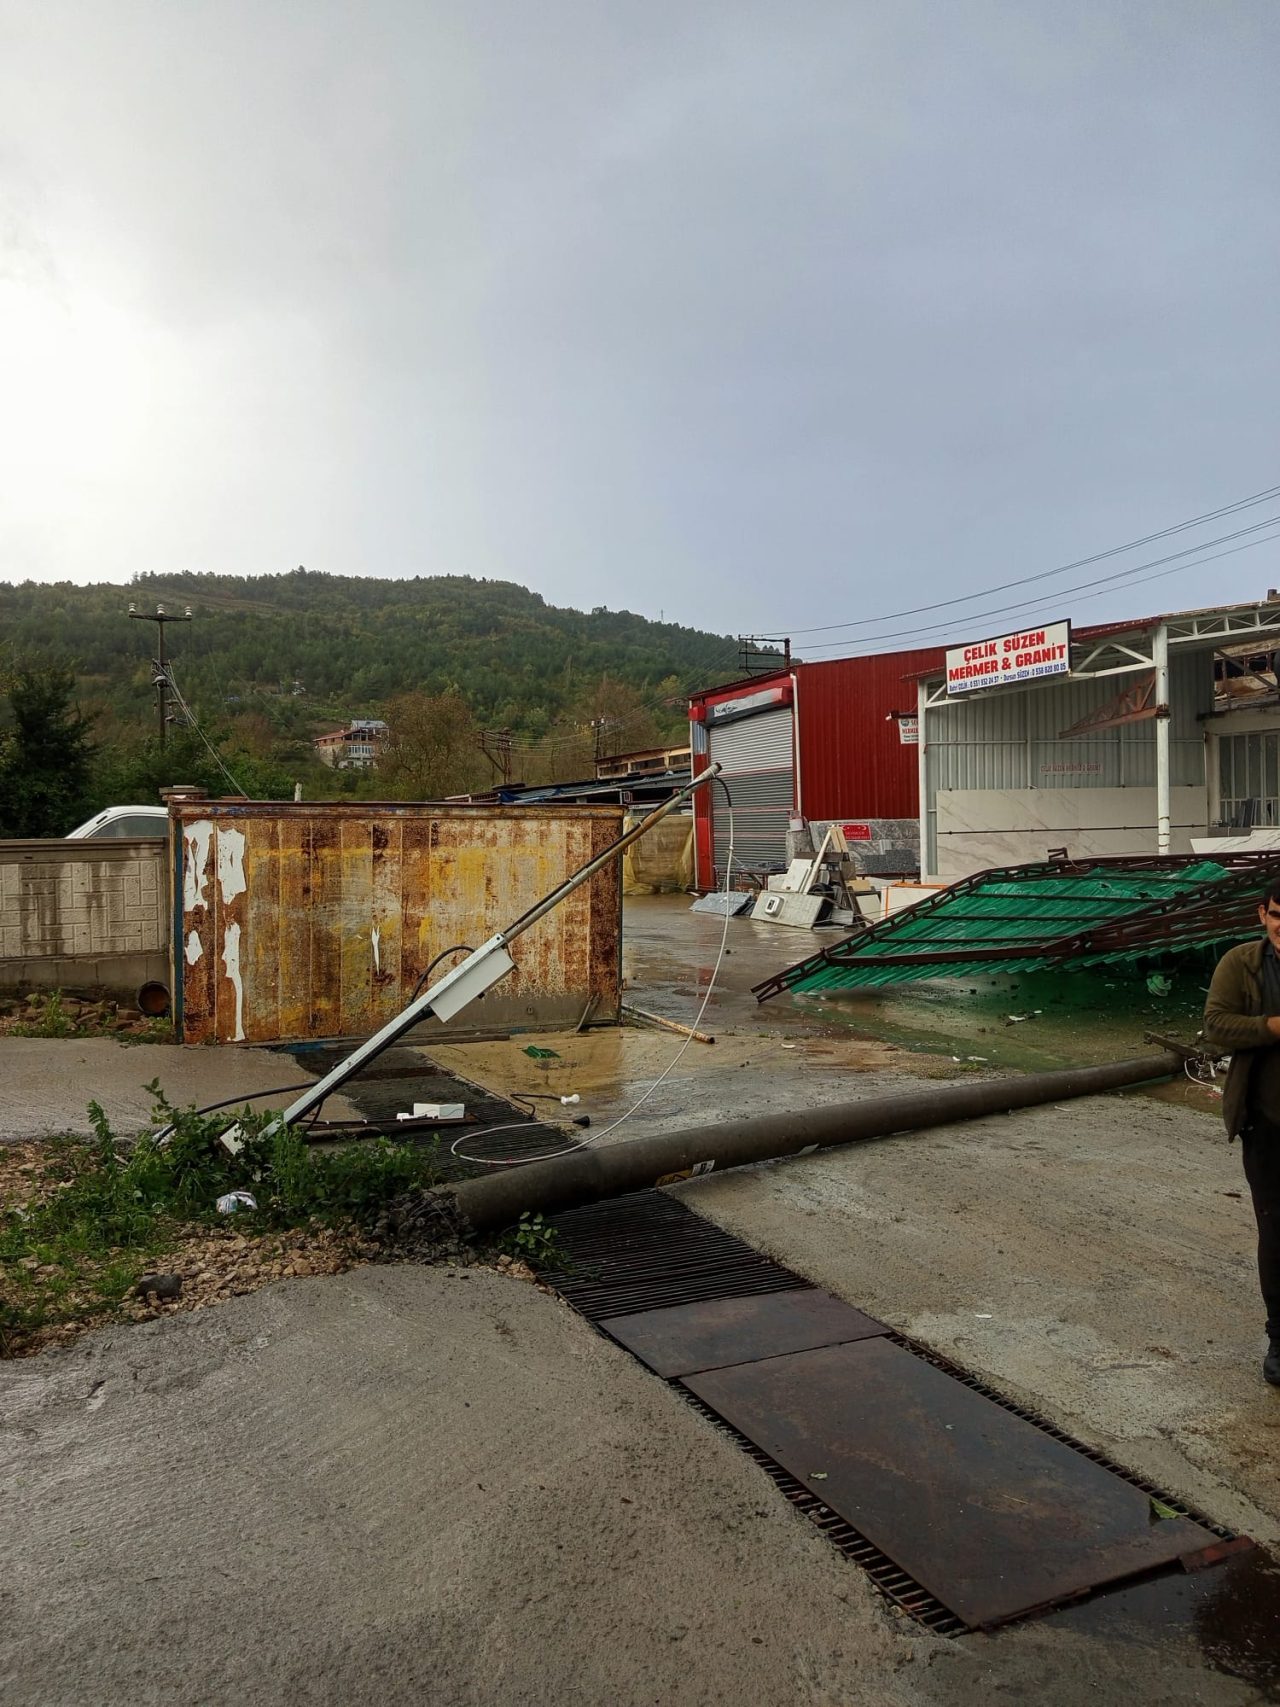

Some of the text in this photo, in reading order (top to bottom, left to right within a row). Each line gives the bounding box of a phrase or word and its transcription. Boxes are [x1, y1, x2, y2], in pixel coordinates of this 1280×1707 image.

[949, 642, 1066, 681] MERMER & GRANİT
[964, 631, 1045, 665] ÇELİK SÜZEN
